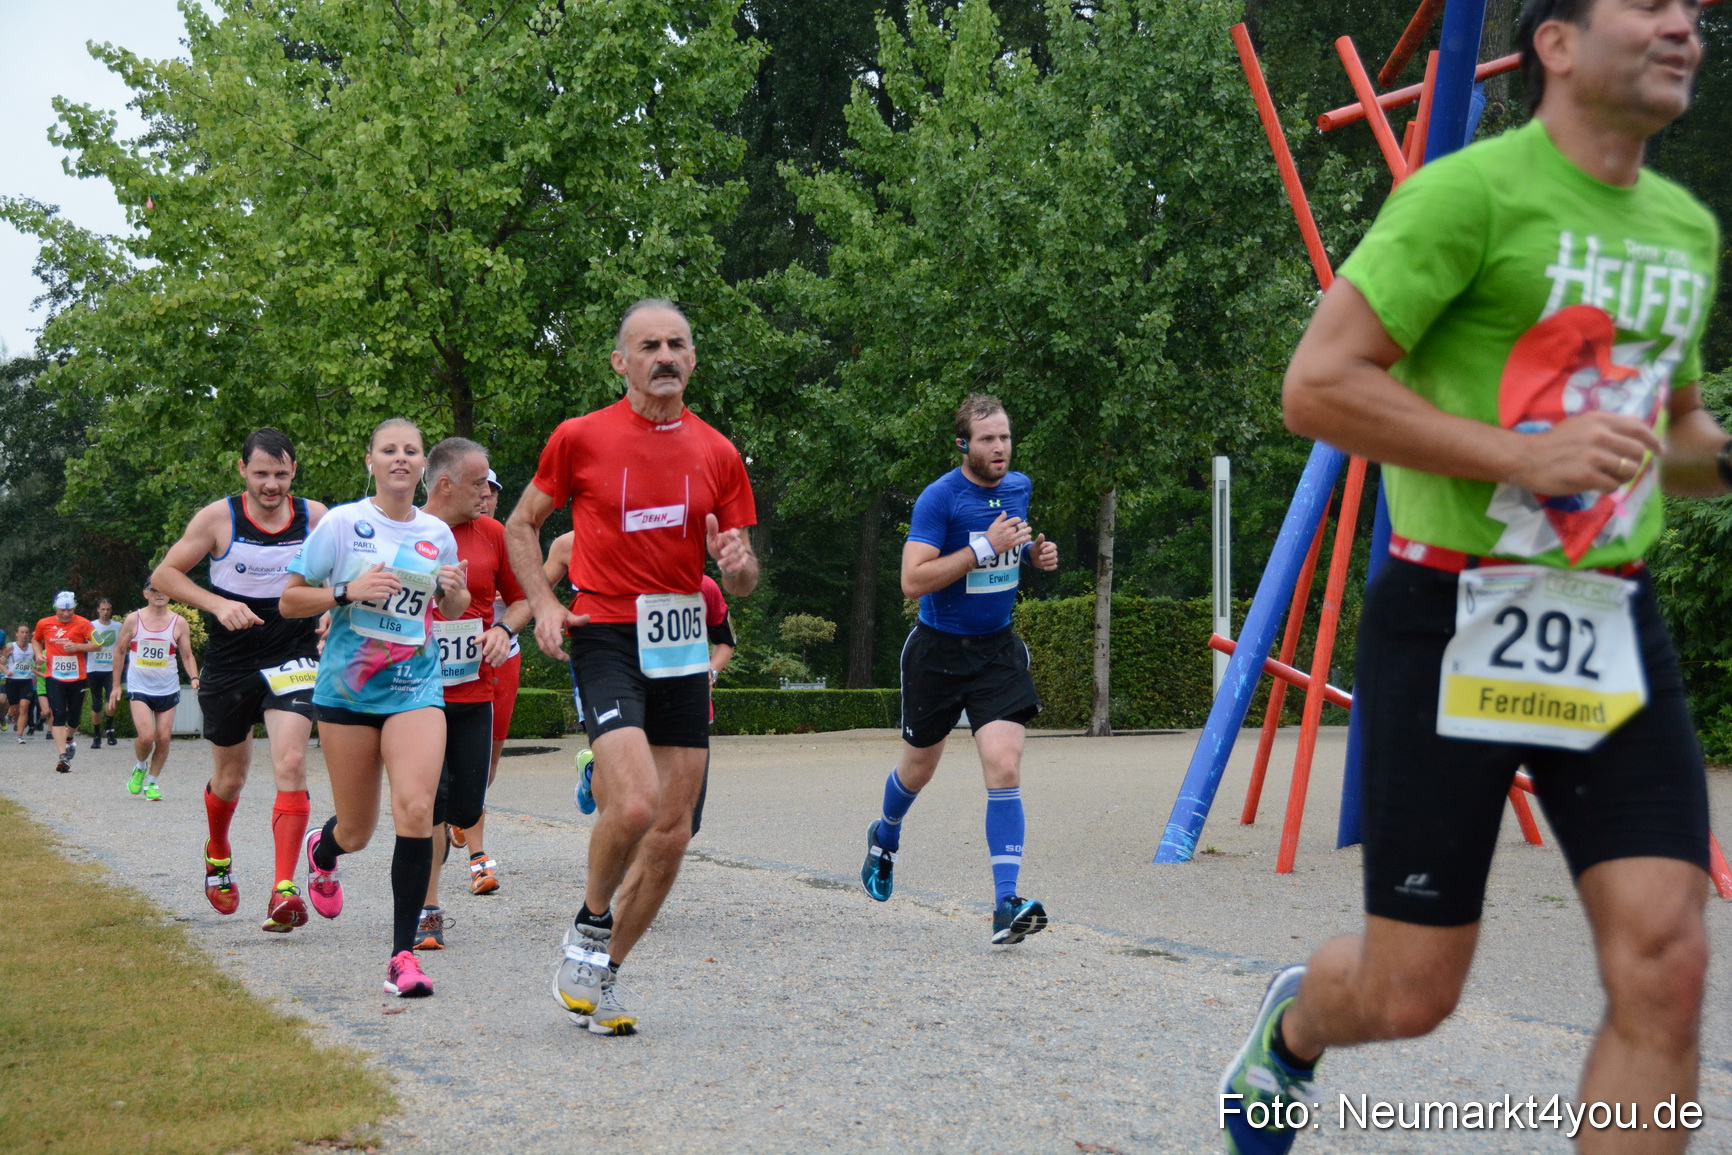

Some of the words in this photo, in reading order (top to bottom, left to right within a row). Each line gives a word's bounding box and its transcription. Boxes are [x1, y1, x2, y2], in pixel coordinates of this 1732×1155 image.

[642, 513, 667, 524] DEHN
[353, 541, 376, 550] PARTL
[975, 544, 1021, 568] 919
[989, 573, 1010, 584] Erwin
[361, 587, 426, 617] 125
[379, 618, 402, 633] Lisa
[647, 607, 702, 643] 3005
[1489, 606, 1600, 680] 292
[95, 652, 113, 660] 2715
[143, 647, 164, 659] 296
[54, 661, 77, 671] 2695
[396, 665, 413, 677] 17.
[1477, 687, 1608, 724] Ferdinand
